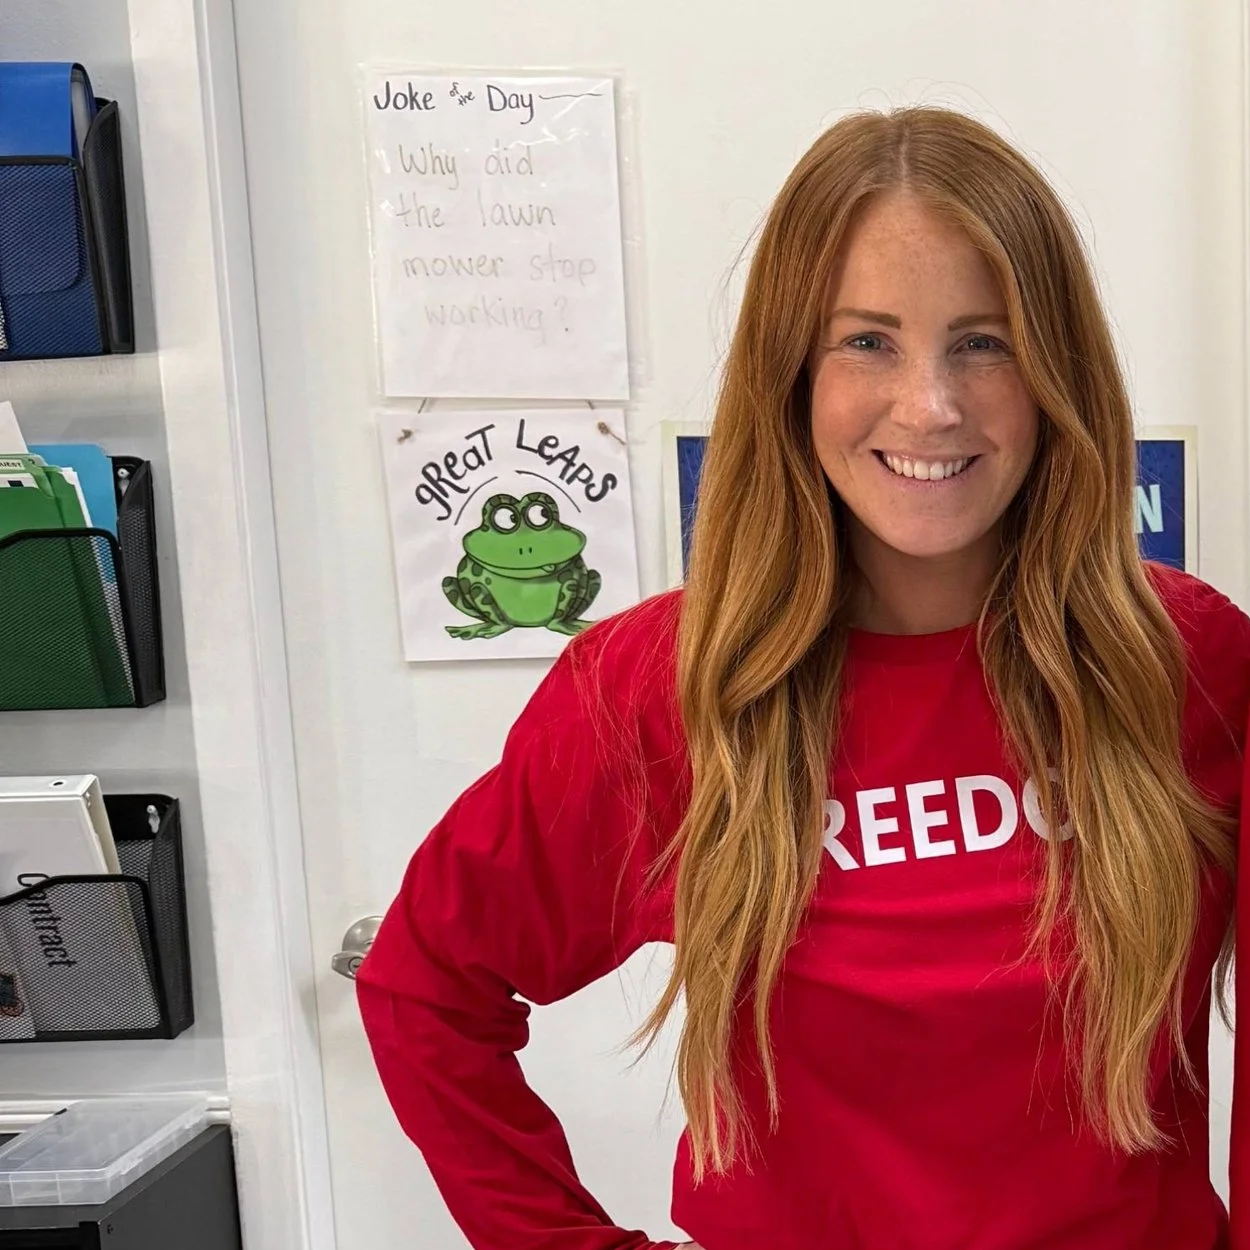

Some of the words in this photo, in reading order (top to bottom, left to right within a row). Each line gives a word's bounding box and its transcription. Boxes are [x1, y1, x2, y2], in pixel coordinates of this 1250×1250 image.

[374, 81, 436, 111] Joke
[457, 90, 476, 107] the
[487, 84, 535, 125] Day
[398, 143, 459, 190] Why
[484, 139, 534, 176] did
[396, 192, 446, 229] the
[477, 189, 556, 227] lawn
[403, 253, 504, 279] mower
[529, 242, 598, 286] stop
[1132, 484, 1164, 534] N
[820, 767, 1076, 872] REEDO
